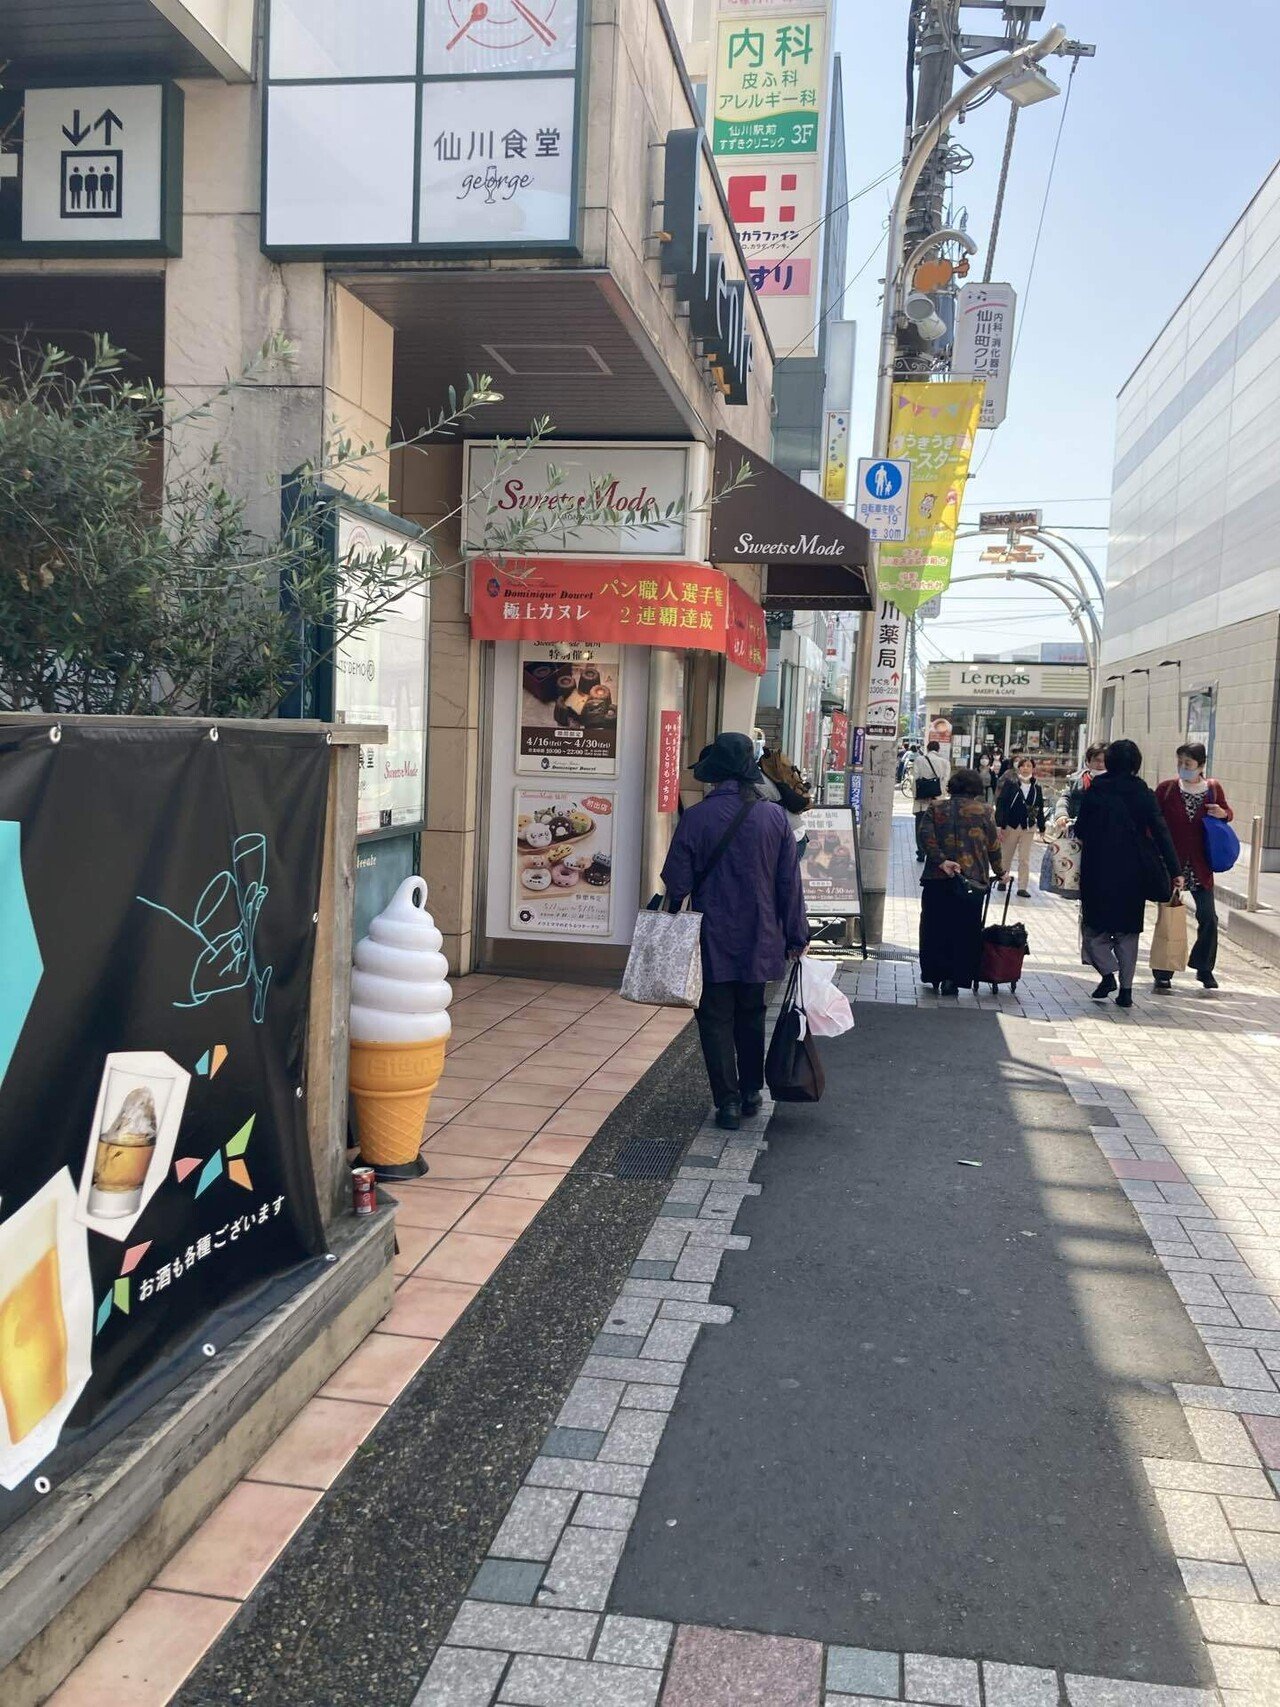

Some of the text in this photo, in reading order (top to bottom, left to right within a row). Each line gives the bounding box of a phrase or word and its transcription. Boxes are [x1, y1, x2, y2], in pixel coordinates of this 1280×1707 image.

[728, 24, 813, 69] 内科
[742, 69, 798, 90] 皮ふ科
[720, 89, 817, 110] アレルギー科
[728, 124, 777, 137] 仙川駅前
[790, 123, 814, 145] 3F
[434, 128, 560, 161] 仙川食堂
[719, 137, 786, 151] すずきクリニック
[456, 173, 534, 201] george
[972, 309, 993, 384] 仙川町クリニ
[503, 602, 590, 621] 極上カヌレ
[961, 672, 1030, 687] Le repas
[138, 1194, 285, 1302] お酒も各種ございます
